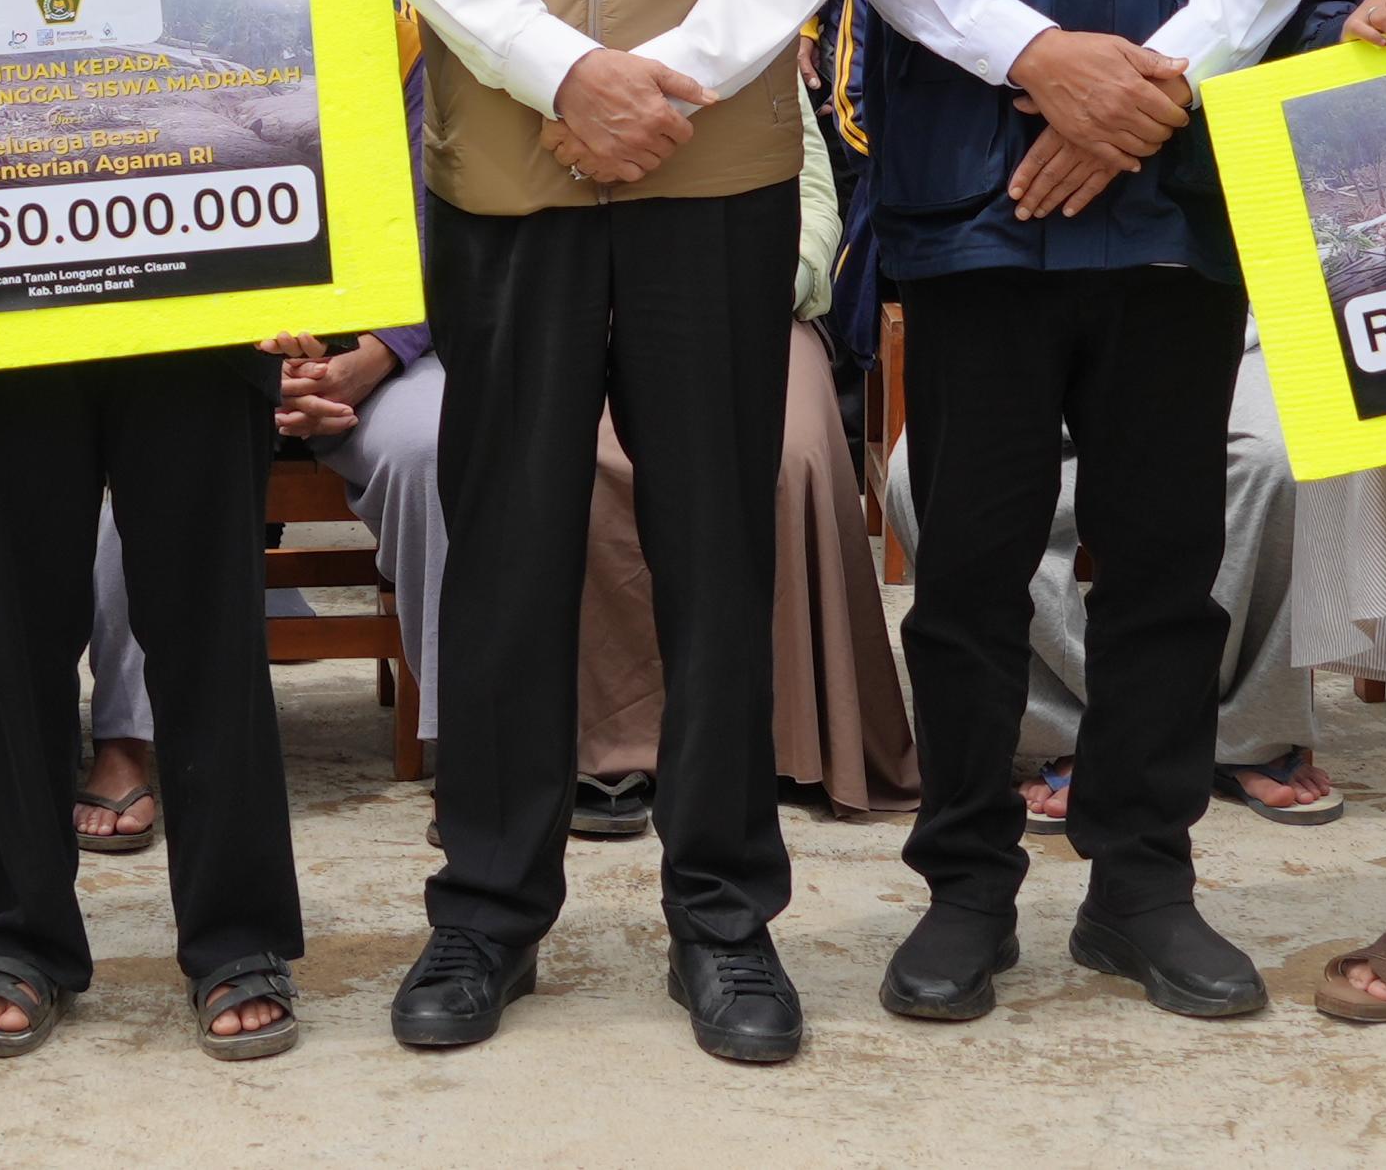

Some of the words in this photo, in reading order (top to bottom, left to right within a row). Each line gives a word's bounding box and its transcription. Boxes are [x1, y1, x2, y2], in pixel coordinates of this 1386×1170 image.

[74, 54, 171, 76] KEPADA
[84, 78, 161, 99] SISWA
[167, 66, 302, 92] MADRASAH
[91, 129, 160, 148] Besar
[96, 151, 182, 175] Agama
[189, 146, 213, 164] RI
[23, 272, 57, 283] Tanah
[59, 267, 104, 280] Longsor
[106, 265, 116, 276] di
[118, 264, 142, 275] Kec.
[145, 261, 186, 272] Cisarua
[28, 287, 52, 297] Kab.
[55, 282, 103, 294] Bandung
[105, 279, 134, 290] Barat
